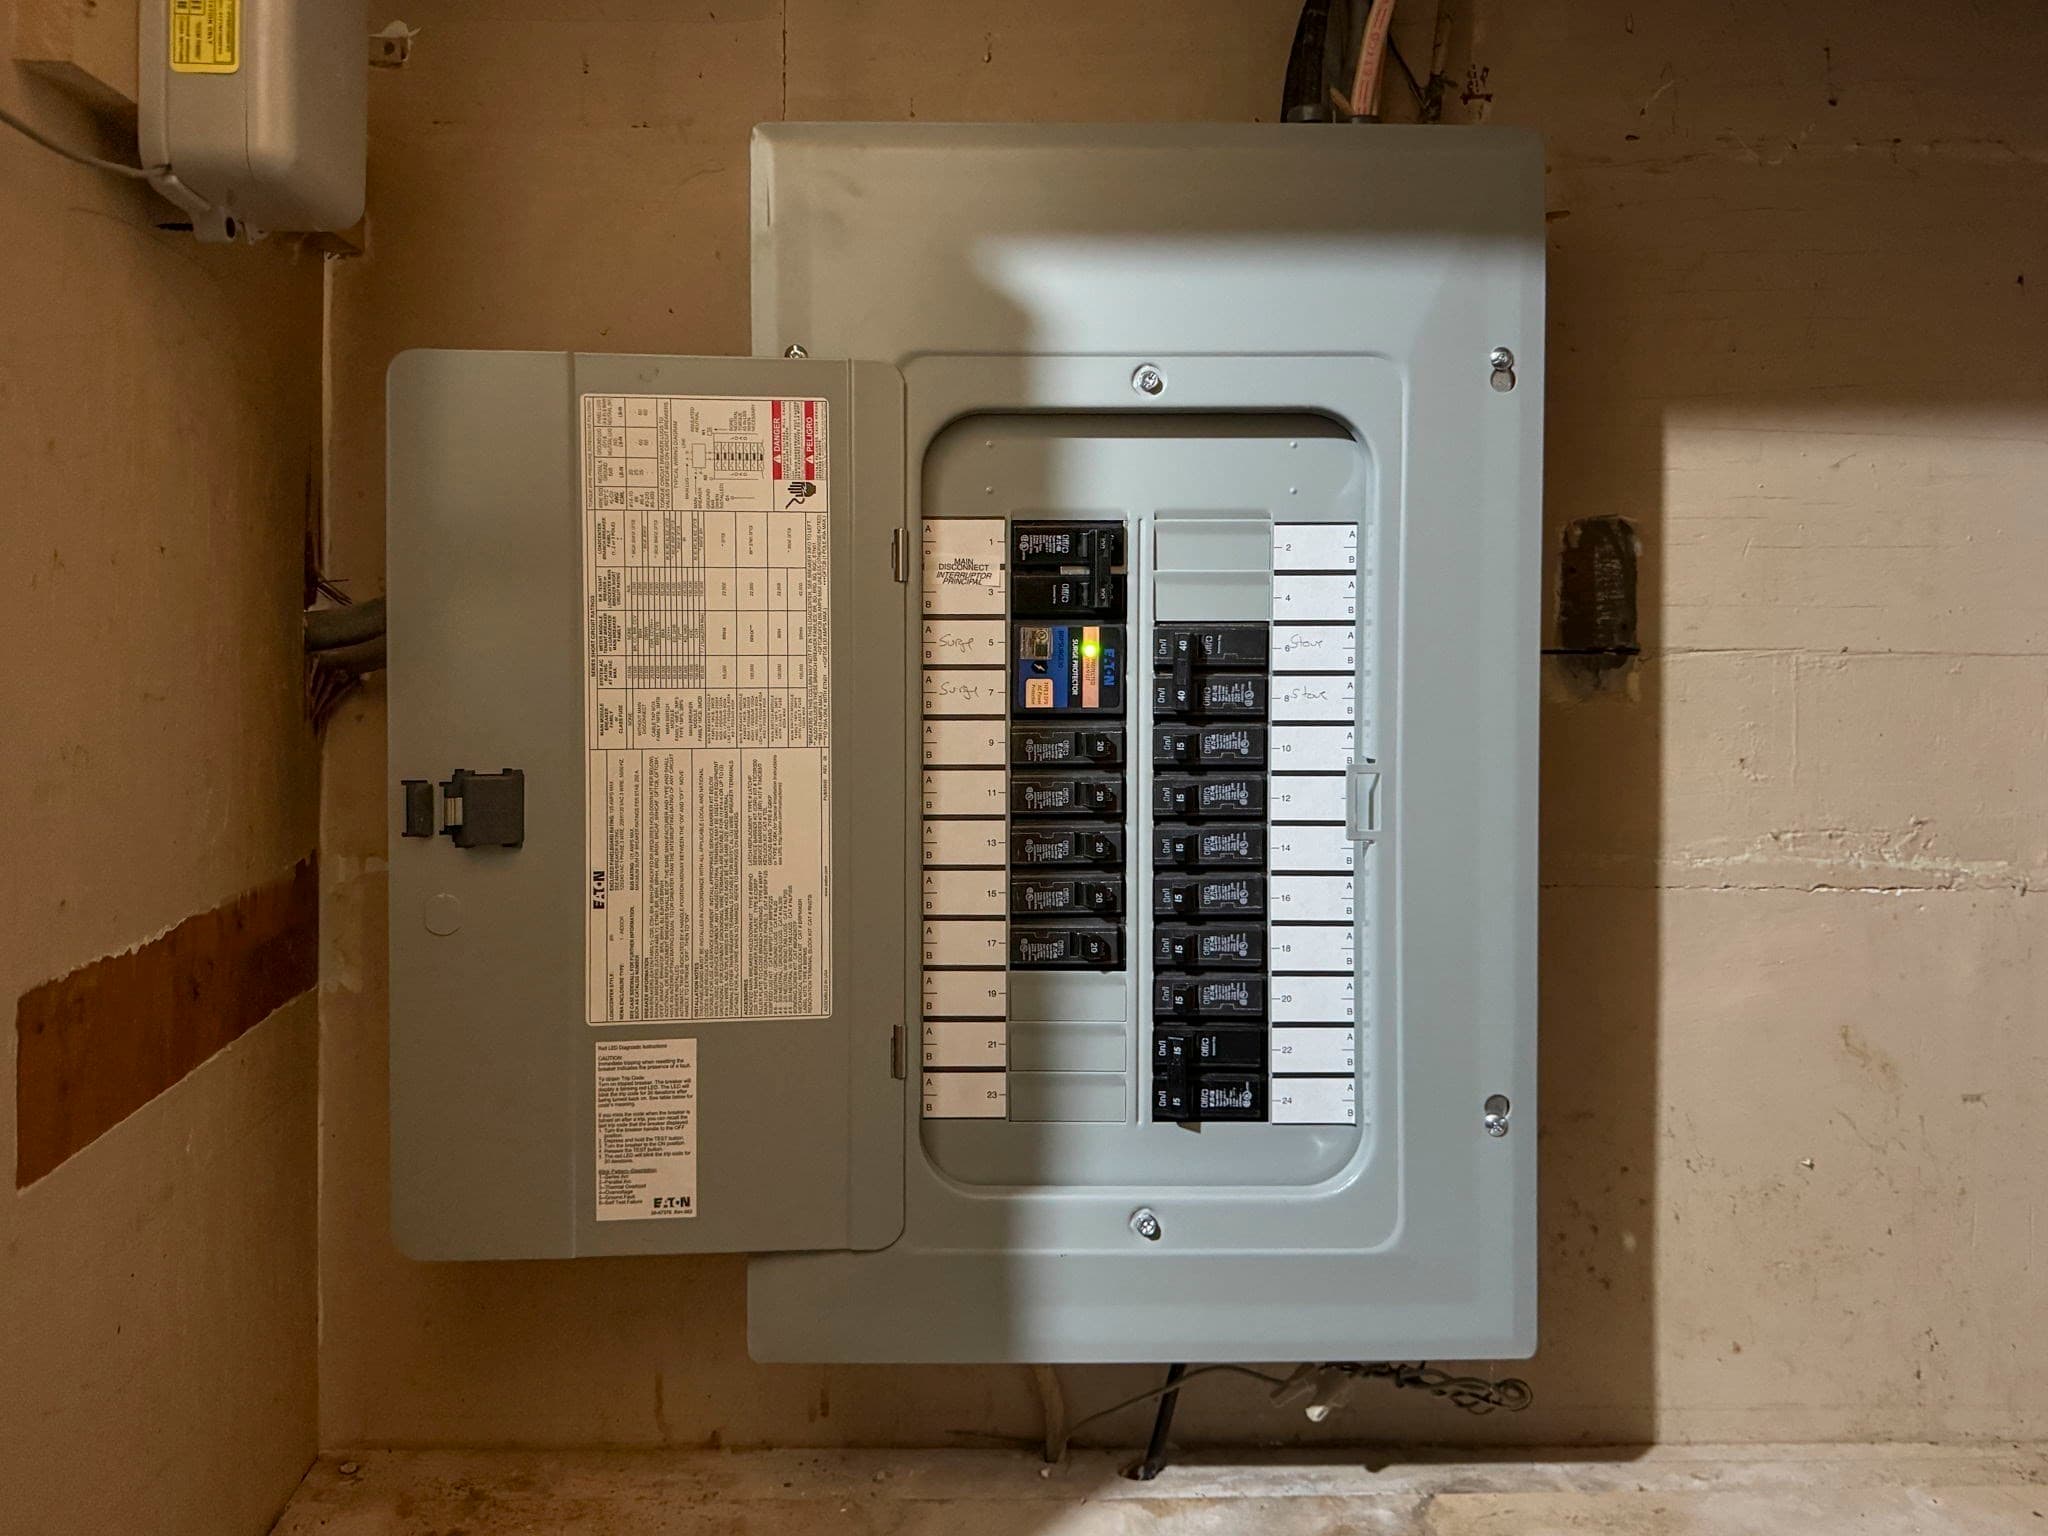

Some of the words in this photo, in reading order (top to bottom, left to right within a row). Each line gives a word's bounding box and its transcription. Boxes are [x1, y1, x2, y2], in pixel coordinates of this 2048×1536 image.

[925, 525, 931, 533] A
[1349, 530, 1356, 538] A
[936, 572, 992, 580] INTERRUPTOR
[942, 578, 982, 586] PRINCIPAL
[1348, 581, 1355, 589] A
[988, 588, 994, 596] 3
[1348, 606, 1354, 614] B
[1179, 640, 1187, 651] 40
[1347, 656, 1353, 664] B
[1178, 690, 1186, 701] 40
[1096, 741, 1104, 752] 20
[926, 776, 932, 784] A
[1096, 791, 1104, 802] 20
[987, 839, 997, 847] 13
[1096, 842, 1104, 853] 20
[926, 851, 932, 859] B
[1096, 892, 1104, 903] 20
[1282, 894, 1291, 902] 16
[1346, 932, 1352, 940] A
[1090, 943, 1098, 953] 20
[1346, 957, 1352, 965] B
[1282, 1046, 1292, 1054] 22
[1347, 1058, 1353, 1066] B
[987, 1091, 997, 1099] 23
[1348, 1109, 1353, 1117] B
